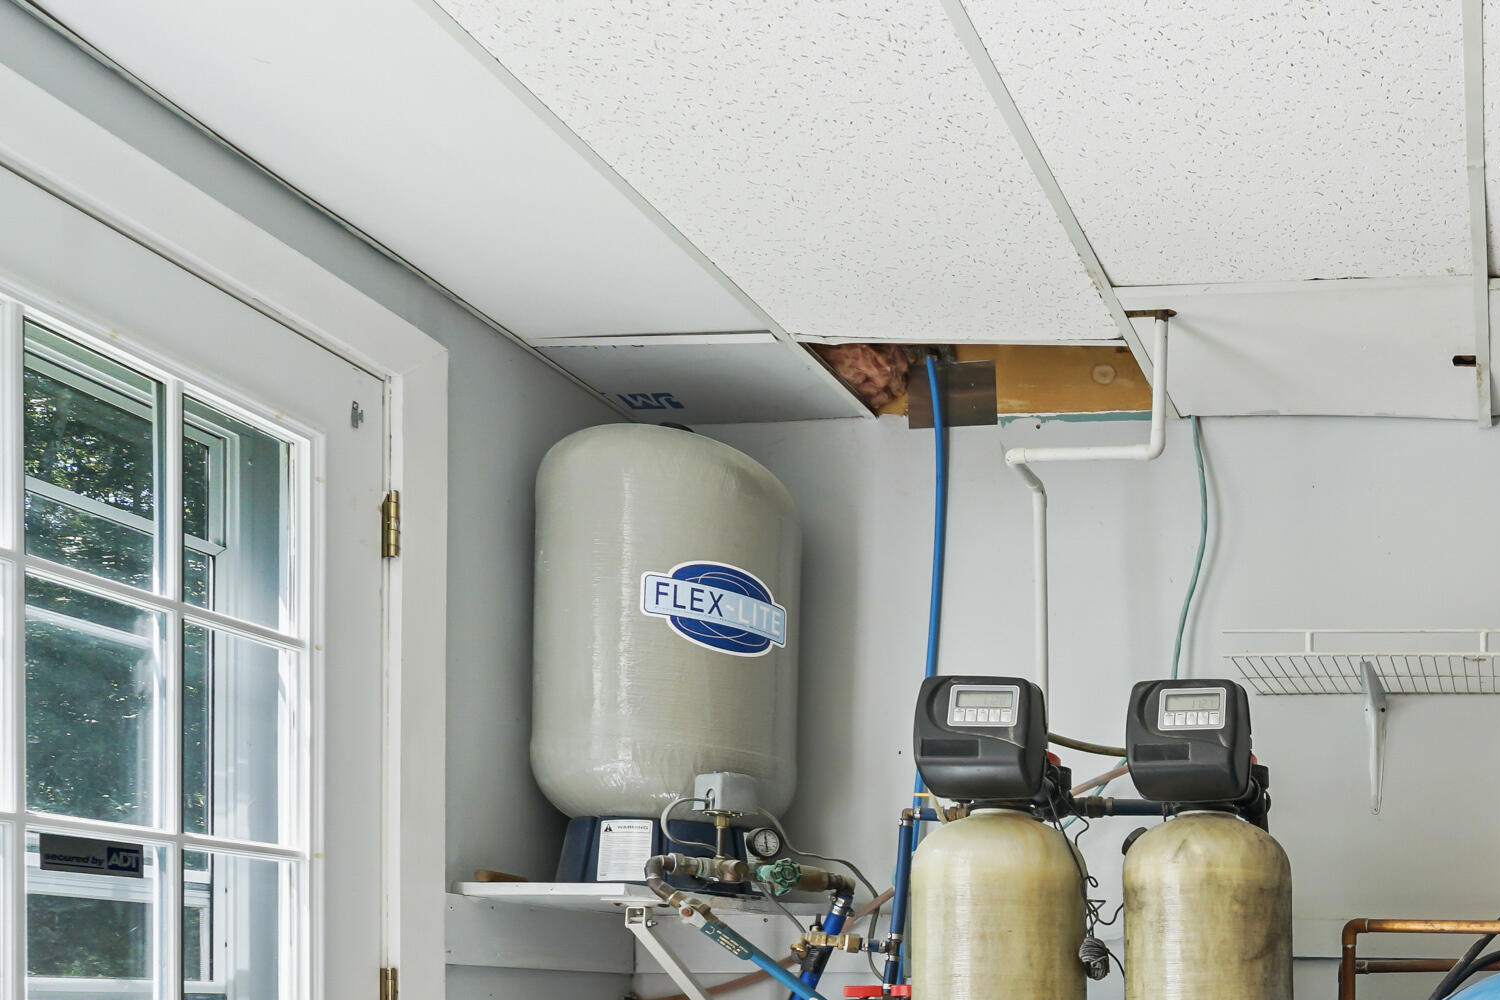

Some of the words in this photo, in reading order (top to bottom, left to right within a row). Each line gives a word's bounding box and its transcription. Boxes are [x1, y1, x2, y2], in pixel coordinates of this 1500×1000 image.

[655, 581, 781, 636] FLEX-LITE
[44, 853, 89, 863] secured
[89, 855, 104, 866] by
[109, 851, 140, 869] ADT
